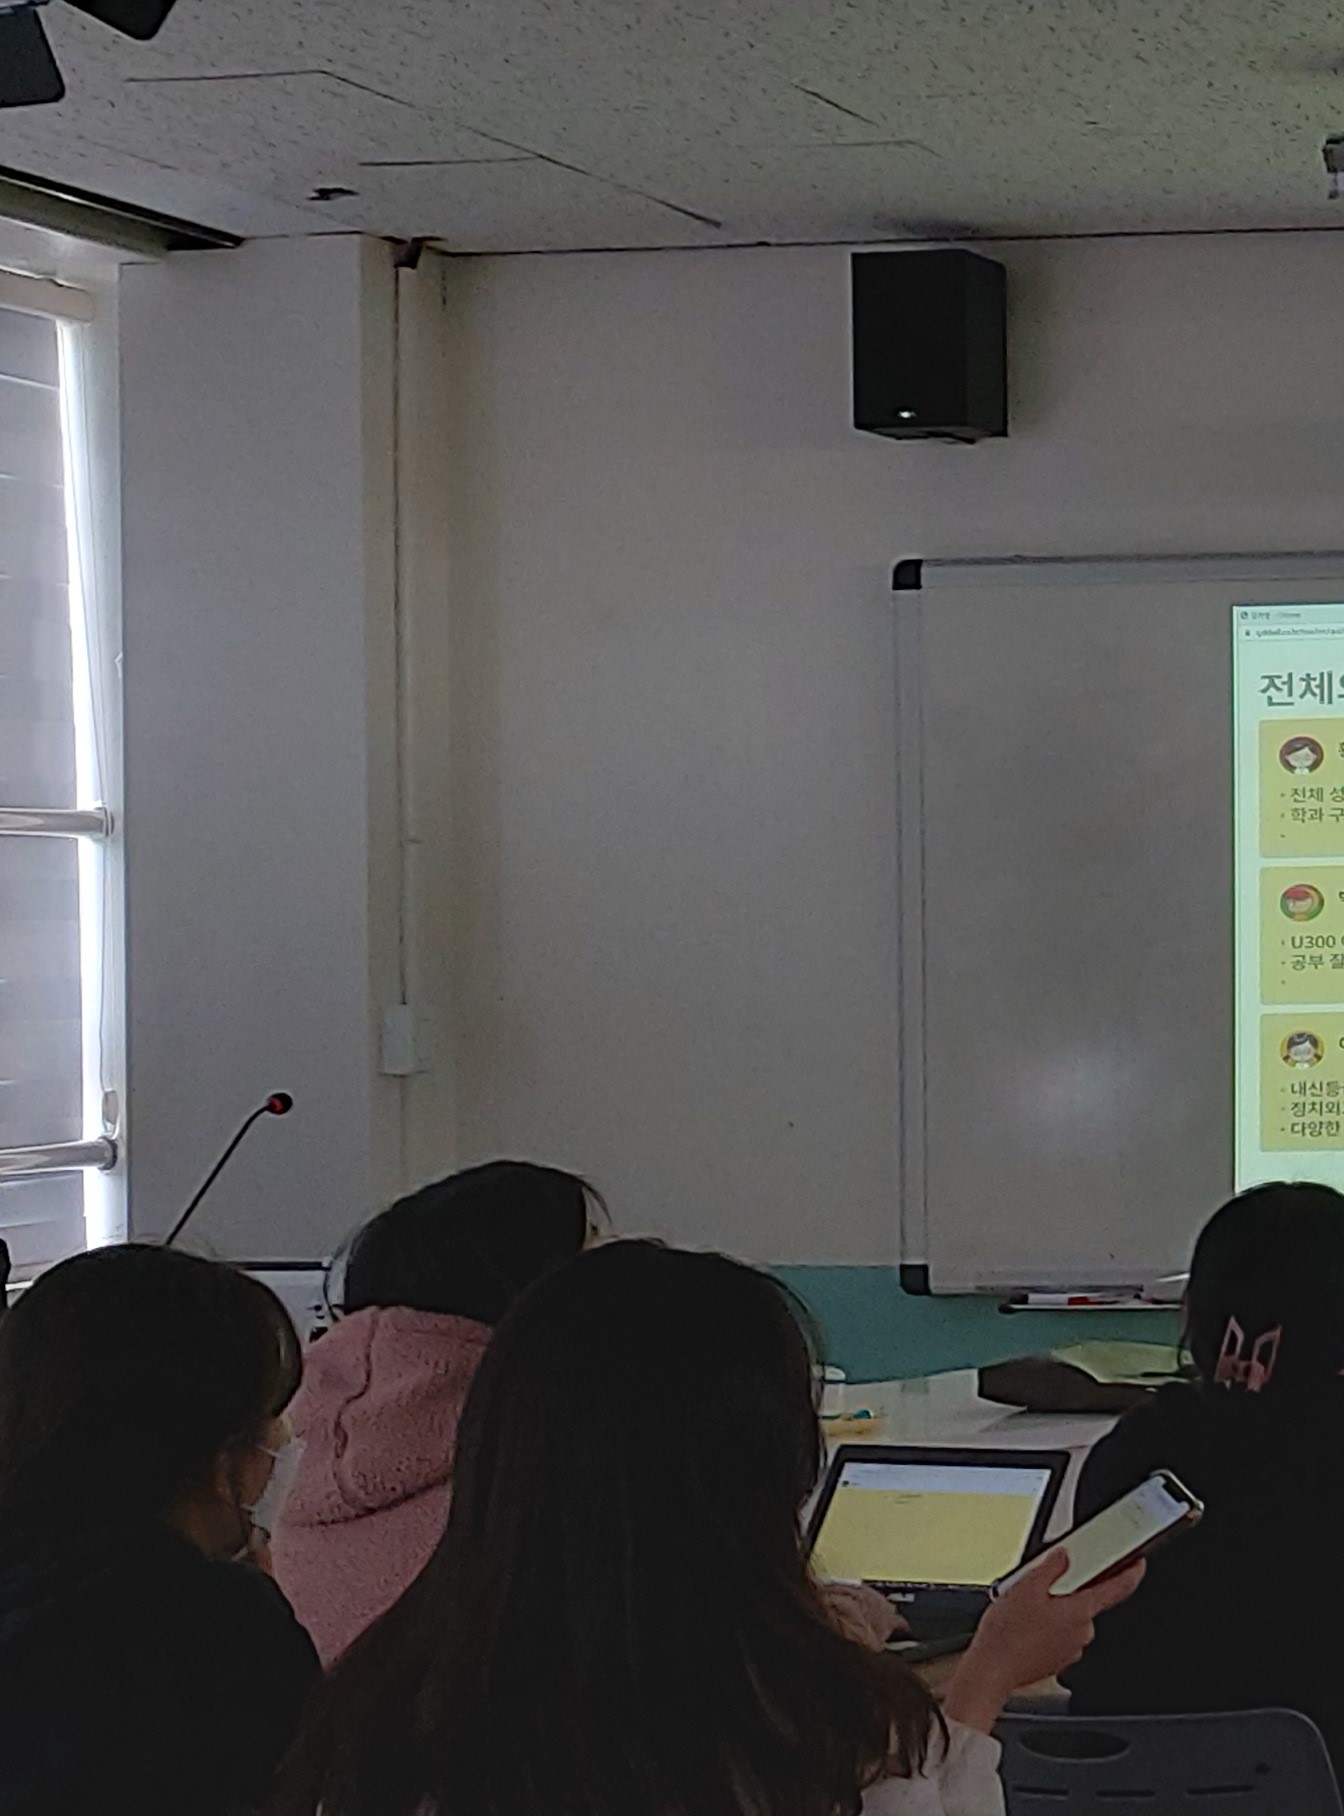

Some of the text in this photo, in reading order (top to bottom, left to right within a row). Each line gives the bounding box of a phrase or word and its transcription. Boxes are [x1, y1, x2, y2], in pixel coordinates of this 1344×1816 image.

[1291, 786, 1324, 803] 전체
[1291, 806, 1324, 823] 학과
[1291, 934, 1336, 949] U300
[1291, 954, 1325, 971] 공부
[1291, 1119, 1340, 1137] 다양한
